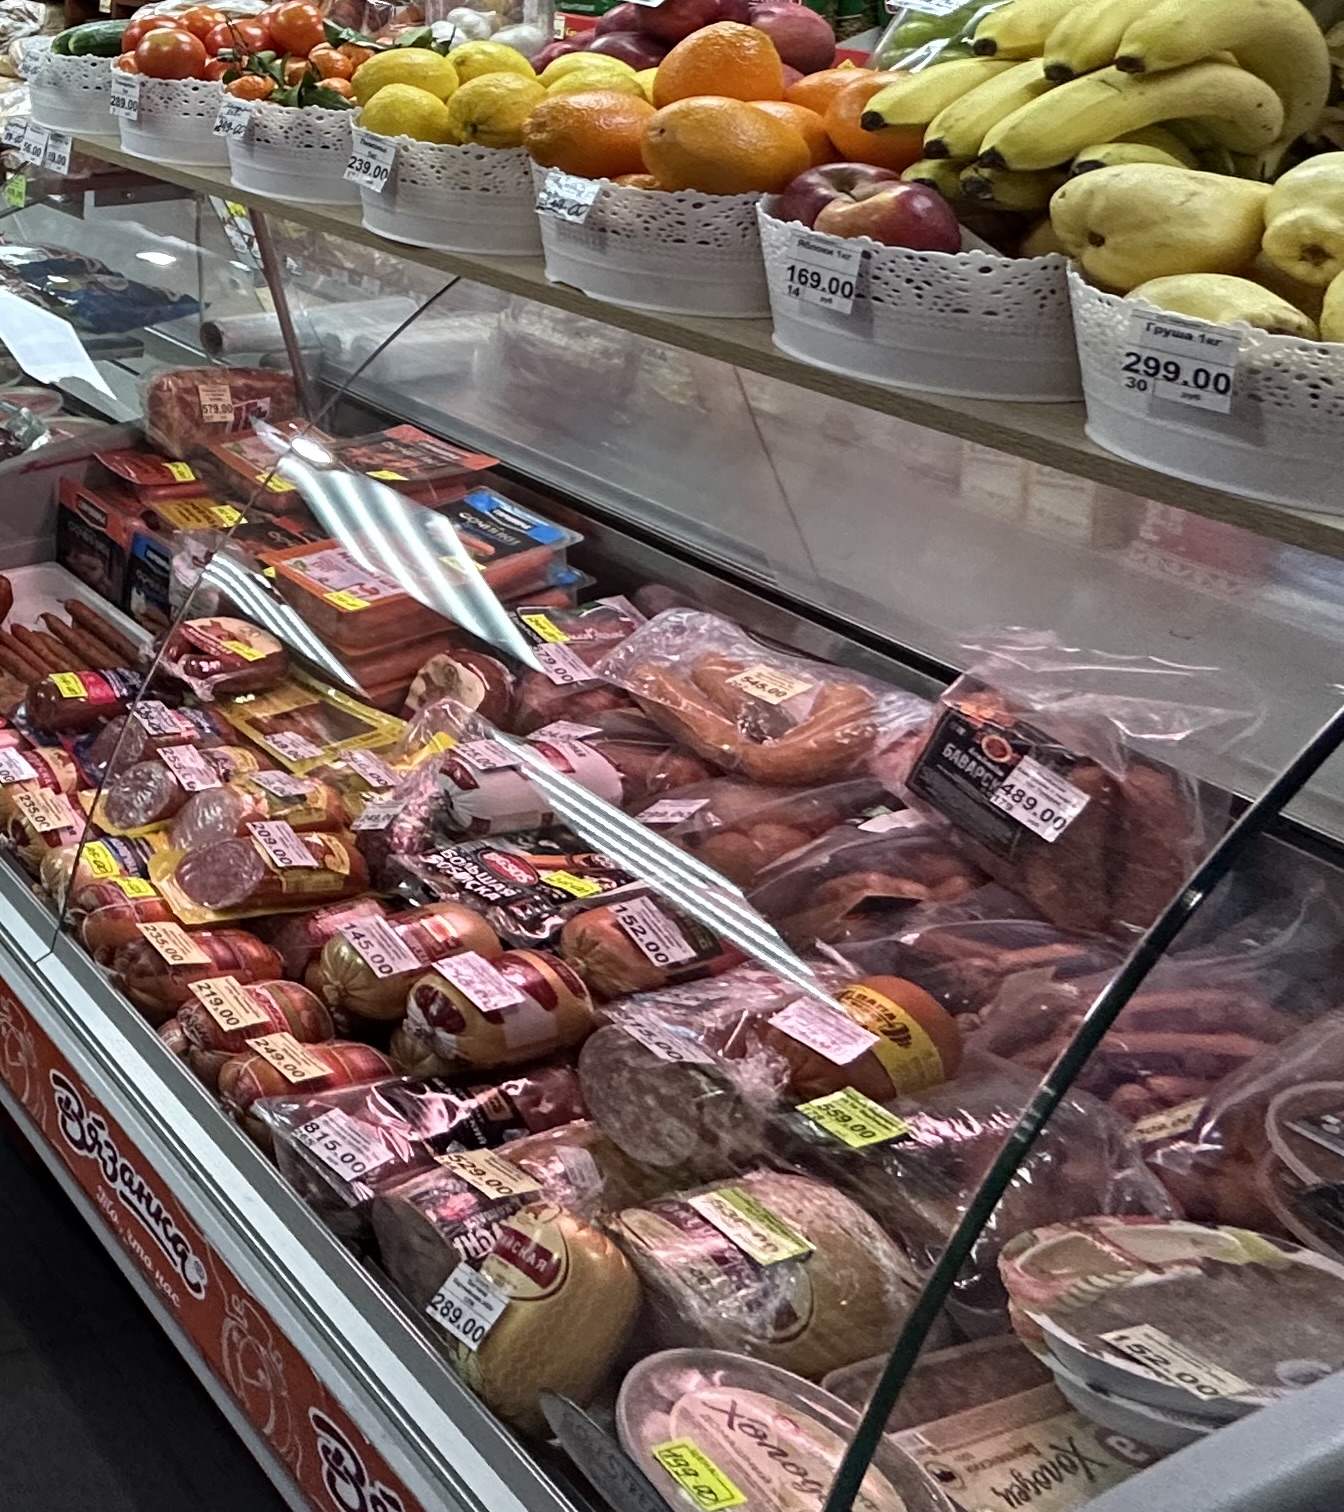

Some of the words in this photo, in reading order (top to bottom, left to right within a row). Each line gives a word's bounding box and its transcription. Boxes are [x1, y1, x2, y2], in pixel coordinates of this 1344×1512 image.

[347, 155, 390, 181] 239.00
[785, 264, 855, 300] 169.00
[1146, 320, 1194, 343] Груша
[1123, 350, 1232, 397] 299.00
[1125, 375, 1148, 393] 30
[1001, 782, 1068, 833] 489.00
[251, 822, 294, 866] 209.00
[144, 924, 185, 964] 235.00
[342, 921, 394, 976] 145.00
[613, 904, 671, 966] 152.00
[196, 981, 241, 1027] 219.00
[254, 1038, 306, 1080] 249.00
[817, 1101, 876, 1140] 559.00
[303, 1118, 367, 1174] 815.00
[49, 1068, 208, 1301] Вязанка
[447, 1153, 513, 1196] 529.00
[430, 1292, 486, 1344] 289.00
[1113, 1334, 1219, 1398] 152.00
